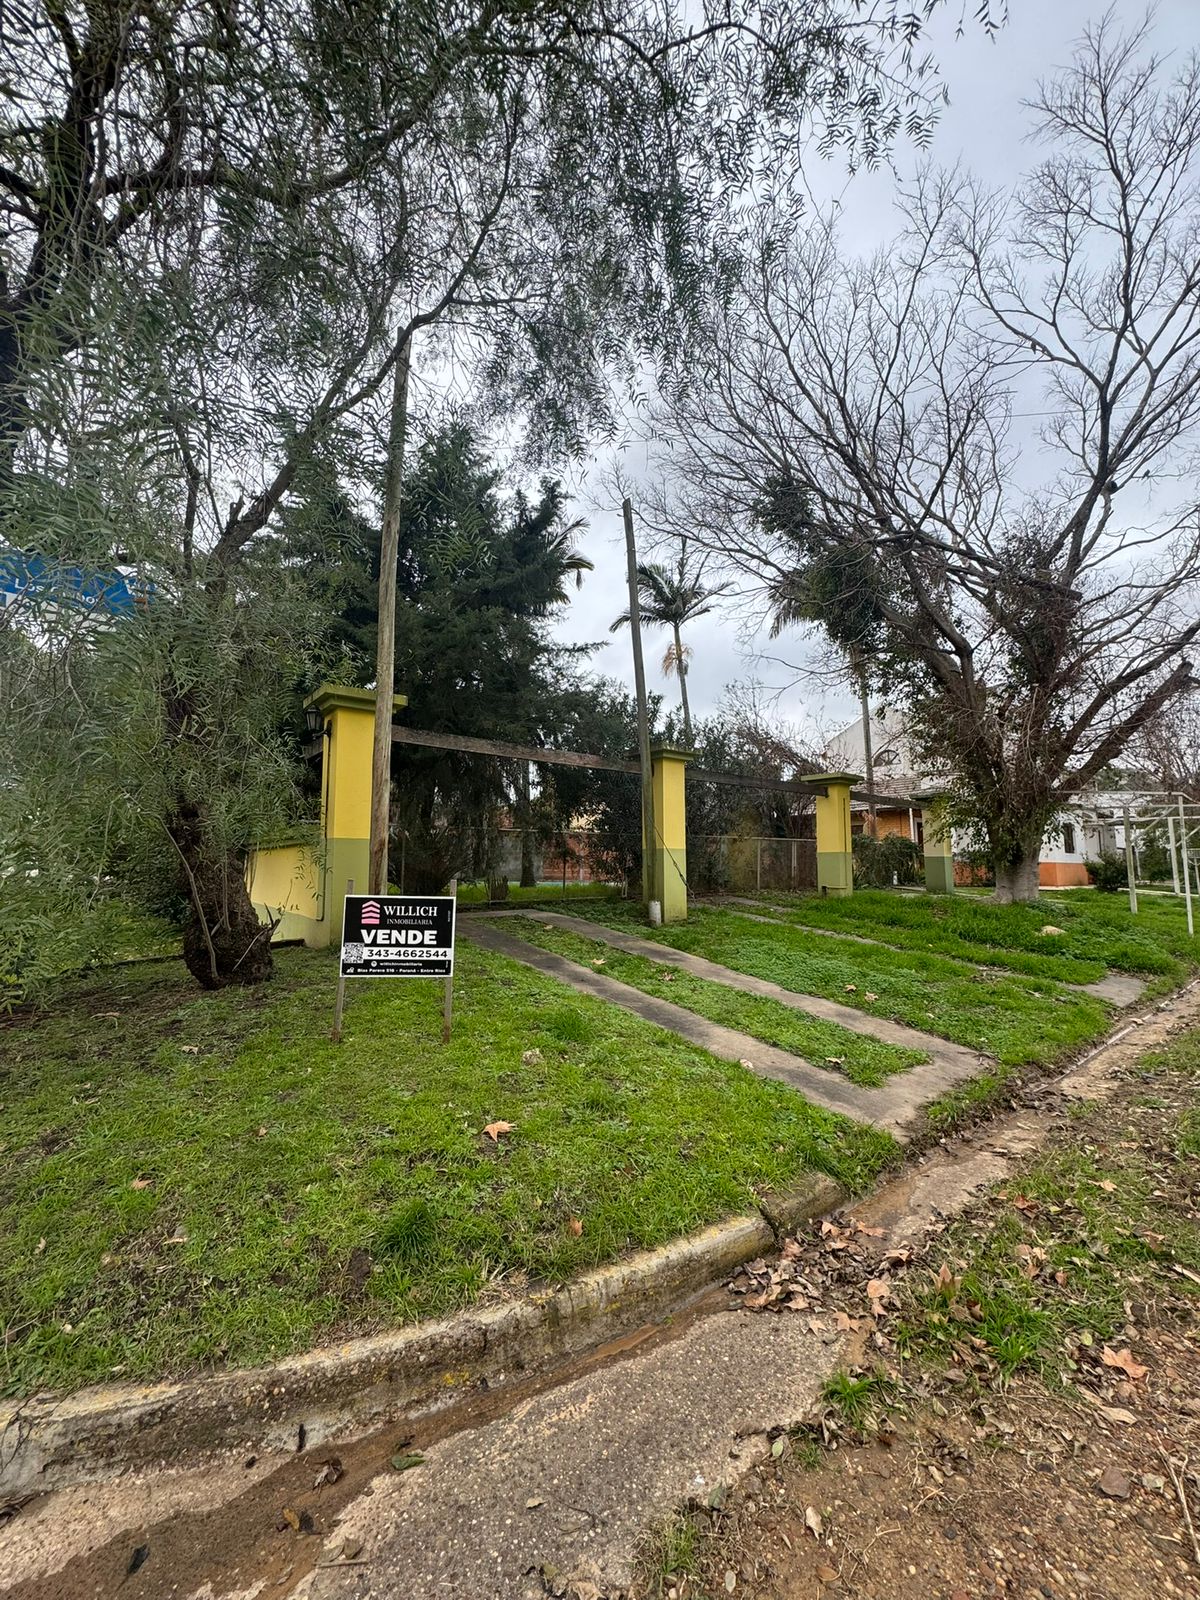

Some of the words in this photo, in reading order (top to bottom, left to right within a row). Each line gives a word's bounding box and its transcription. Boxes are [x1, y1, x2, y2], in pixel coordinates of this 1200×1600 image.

[383, 905, 438, 917] WILLICH
[386, 918, 433, 926] INMOBILIARIA
[360, 929, 438, 945] VENDE
[367, 949, 448, 958] 343-4662544
